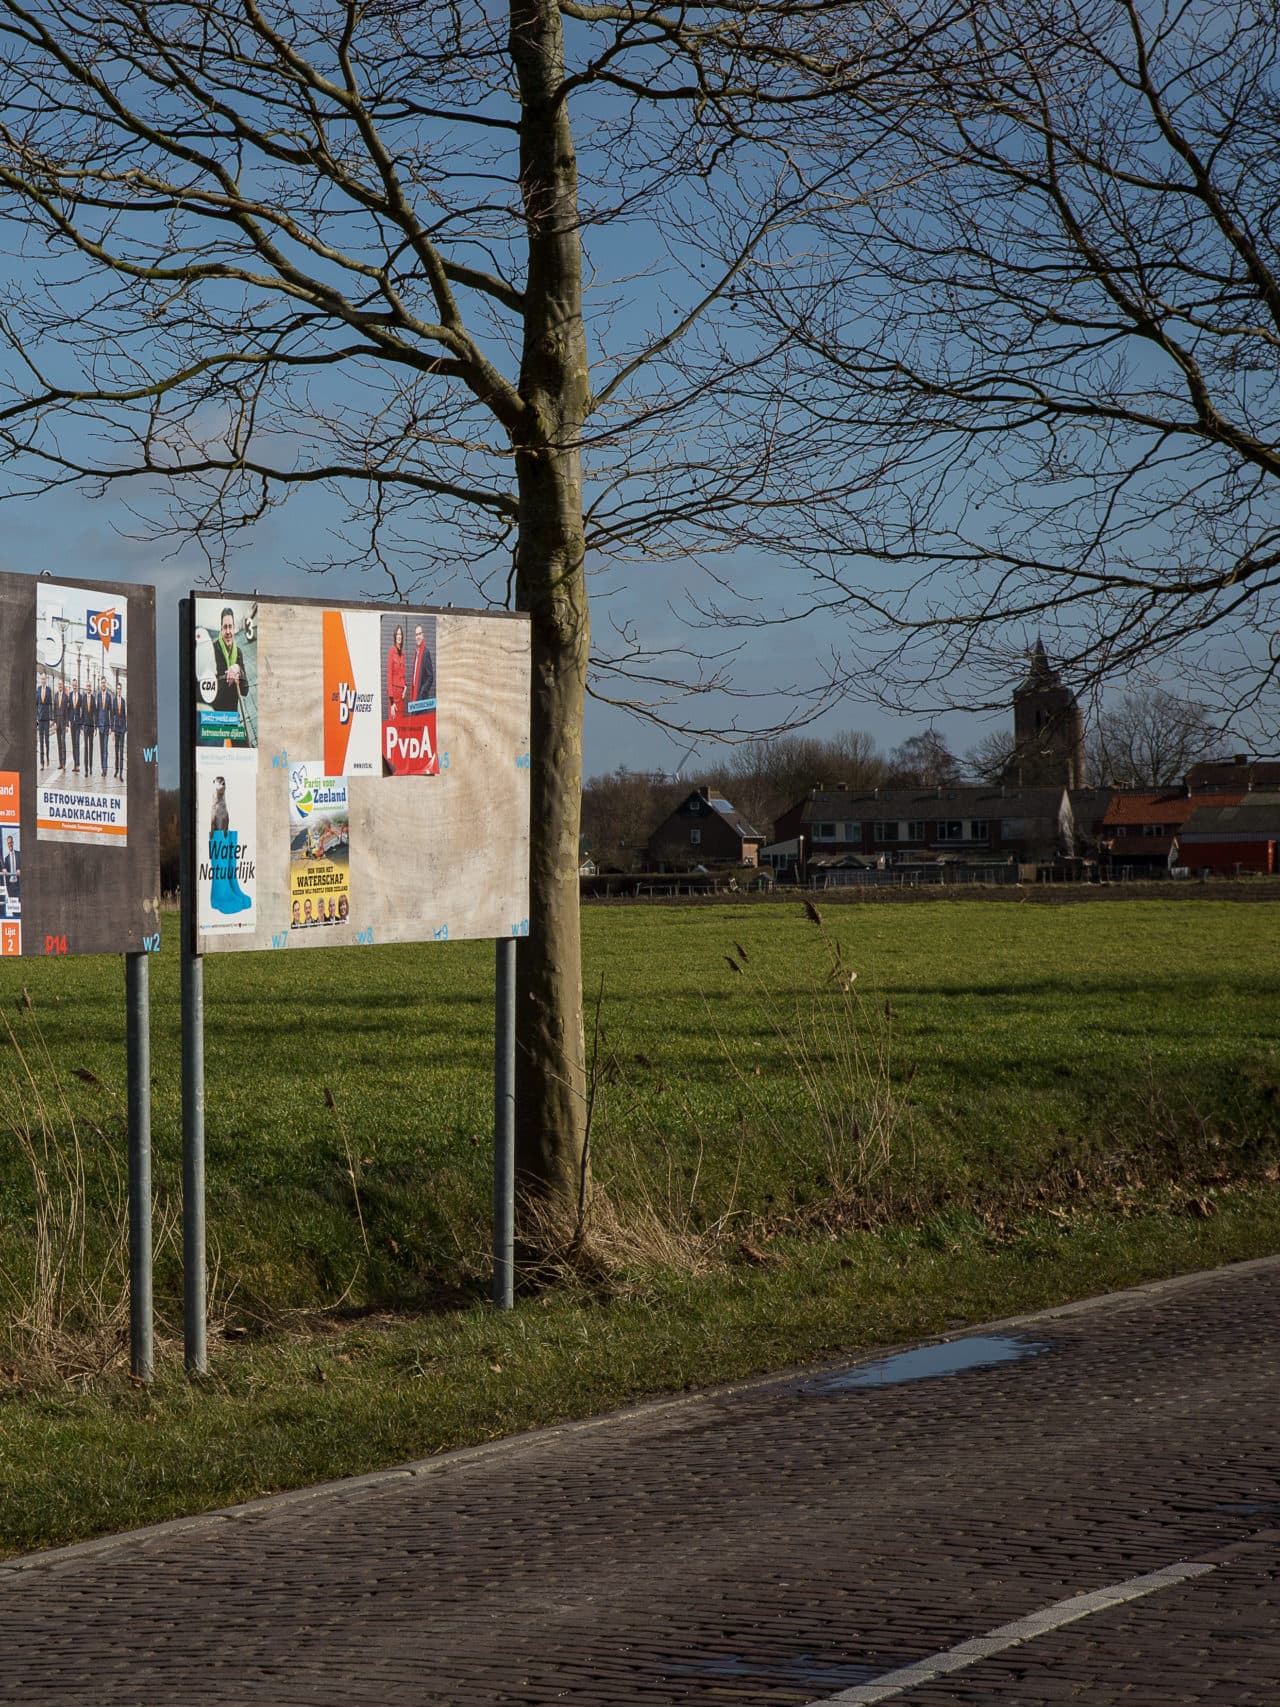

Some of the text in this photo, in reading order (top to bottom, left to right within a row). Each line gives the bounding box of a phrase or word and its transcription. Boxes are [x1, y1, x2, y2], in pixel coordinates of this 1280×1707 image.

[89, 615, 120, 637] SGP
[245, 618, 254, 639] 3
[201, 681, 216, 691] CDA
[43, 792, 121, 809] BETROUWBAAR EN
[313, 787, 346, 803] Zeeland
[49, 807, 116, 823] DAADKRACHTIG
[209, 841, 247, 860] Water
[199, 861, 256, 884] Natuurlijk
[297, 873, 344, 887] WATERSCHAP
[7, 939, 14, 952] 2
